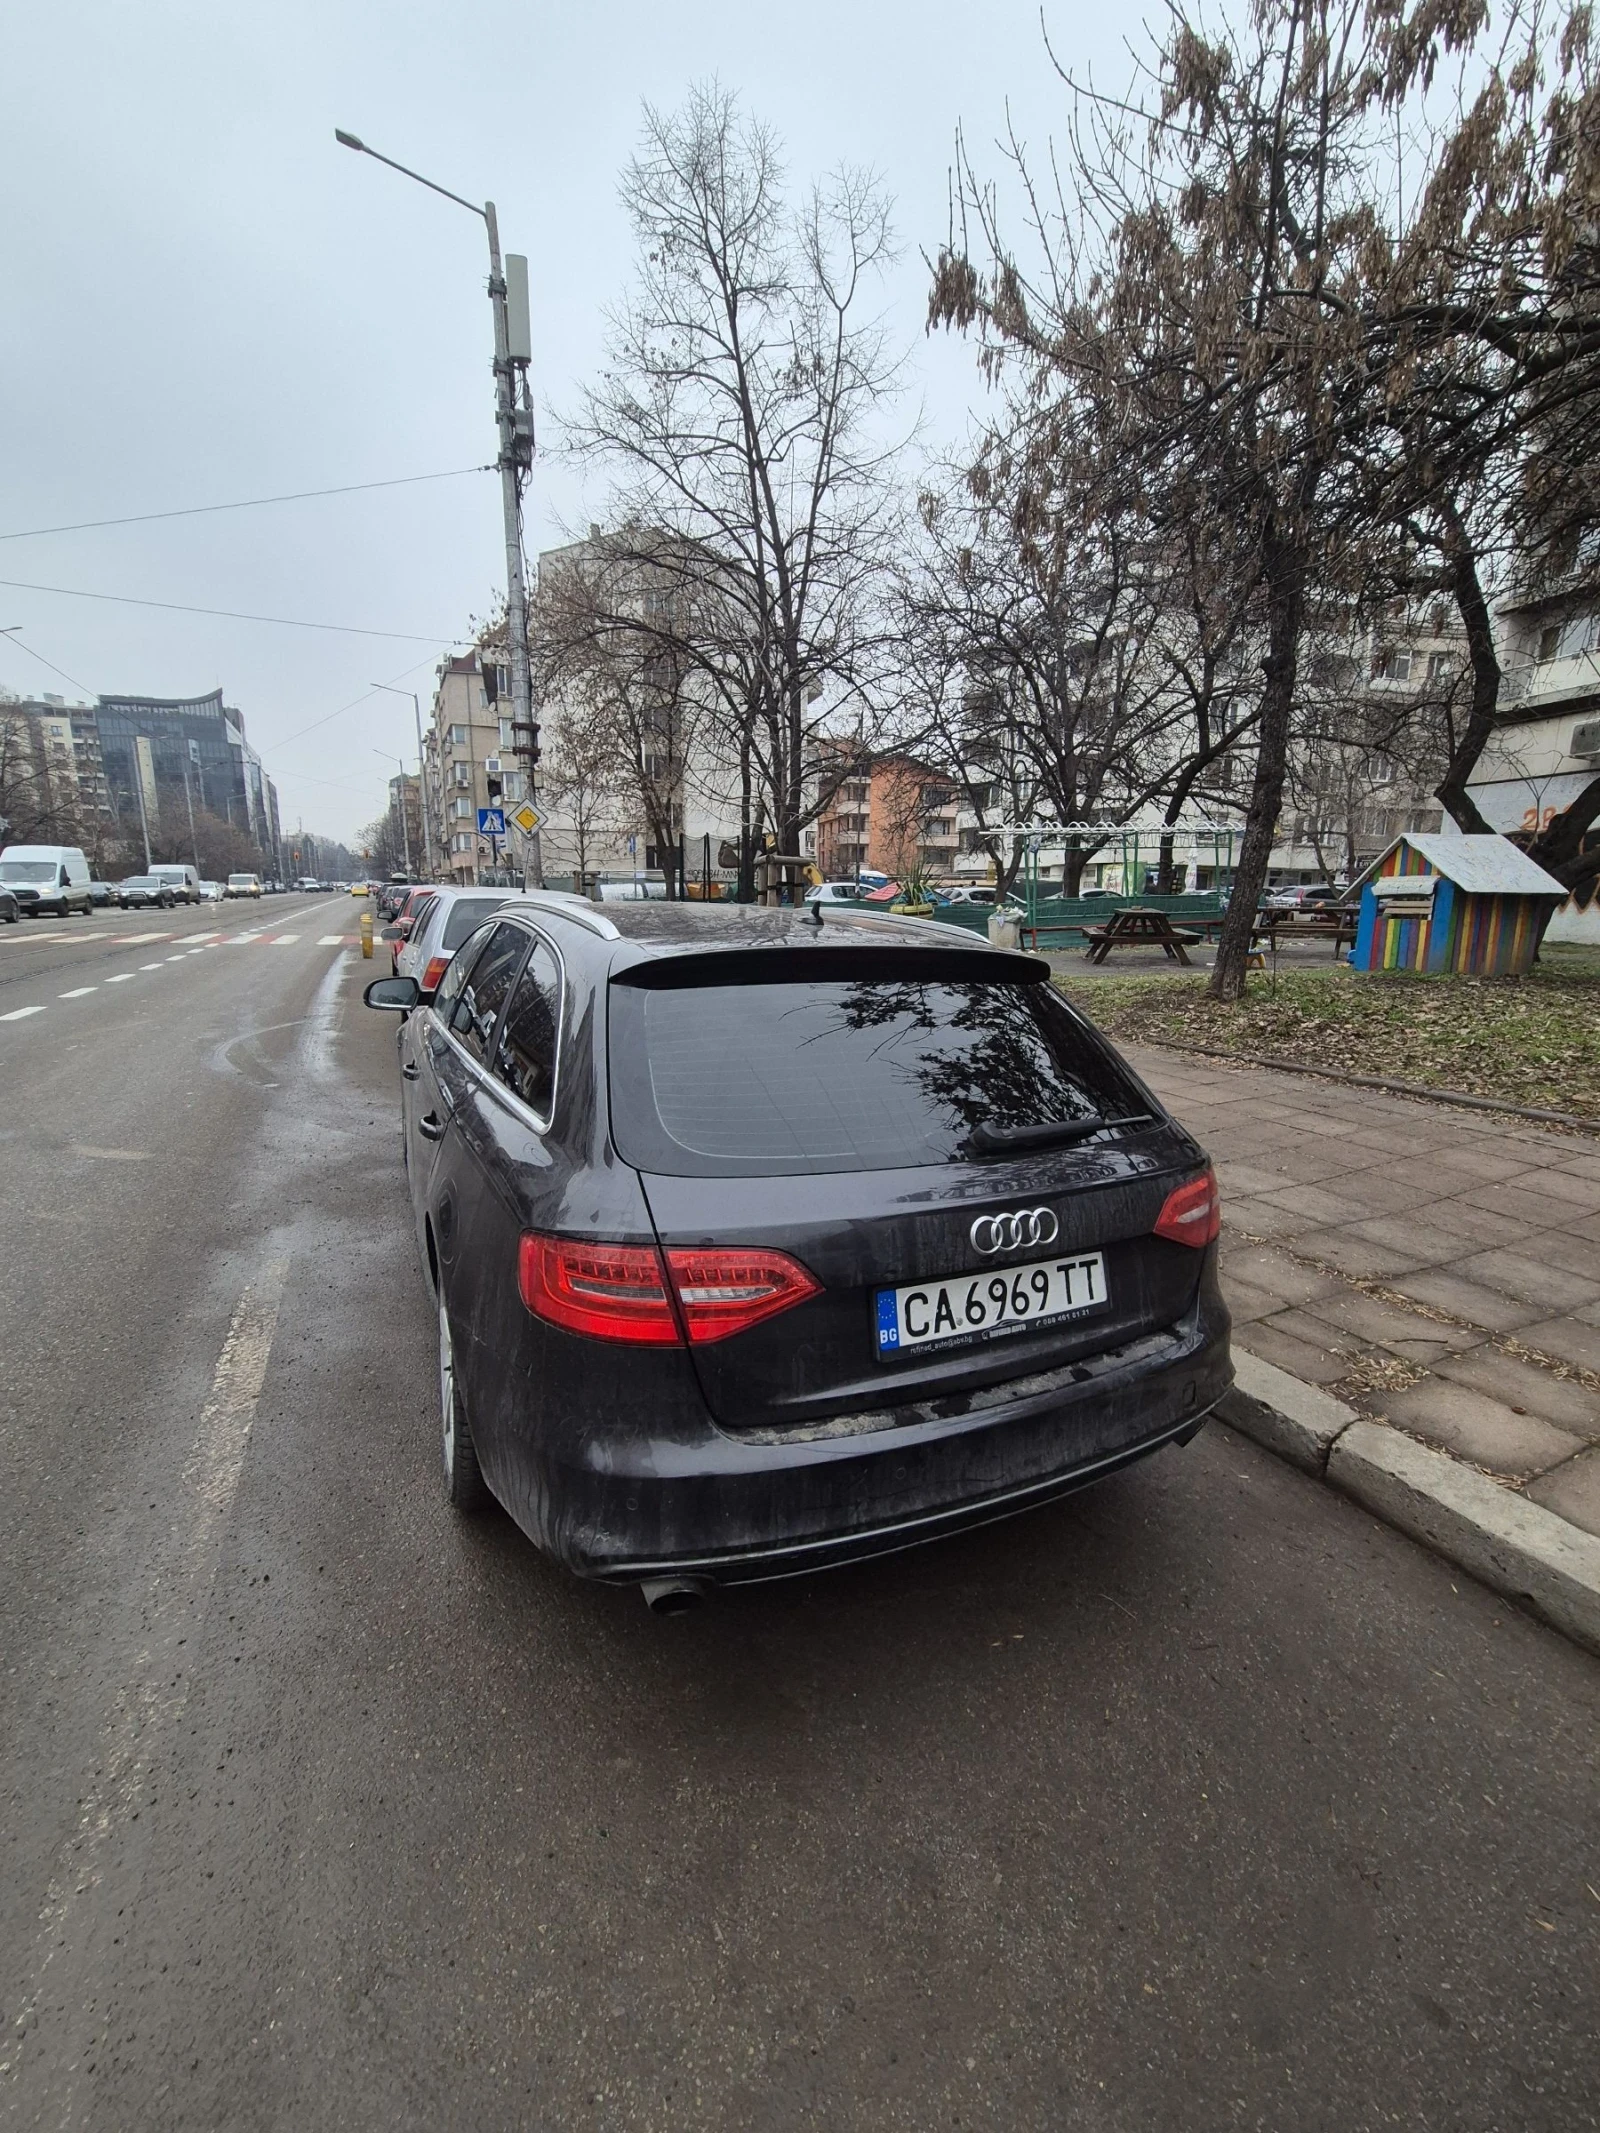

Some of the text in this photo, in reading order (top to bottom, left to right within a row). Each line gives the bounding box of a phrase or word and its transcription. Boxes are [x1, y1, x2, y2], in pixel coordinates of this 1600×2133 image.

[904, 1259, 1099, 1337] CA 6969 TT
[880, 1328, 898, 1344] BG
